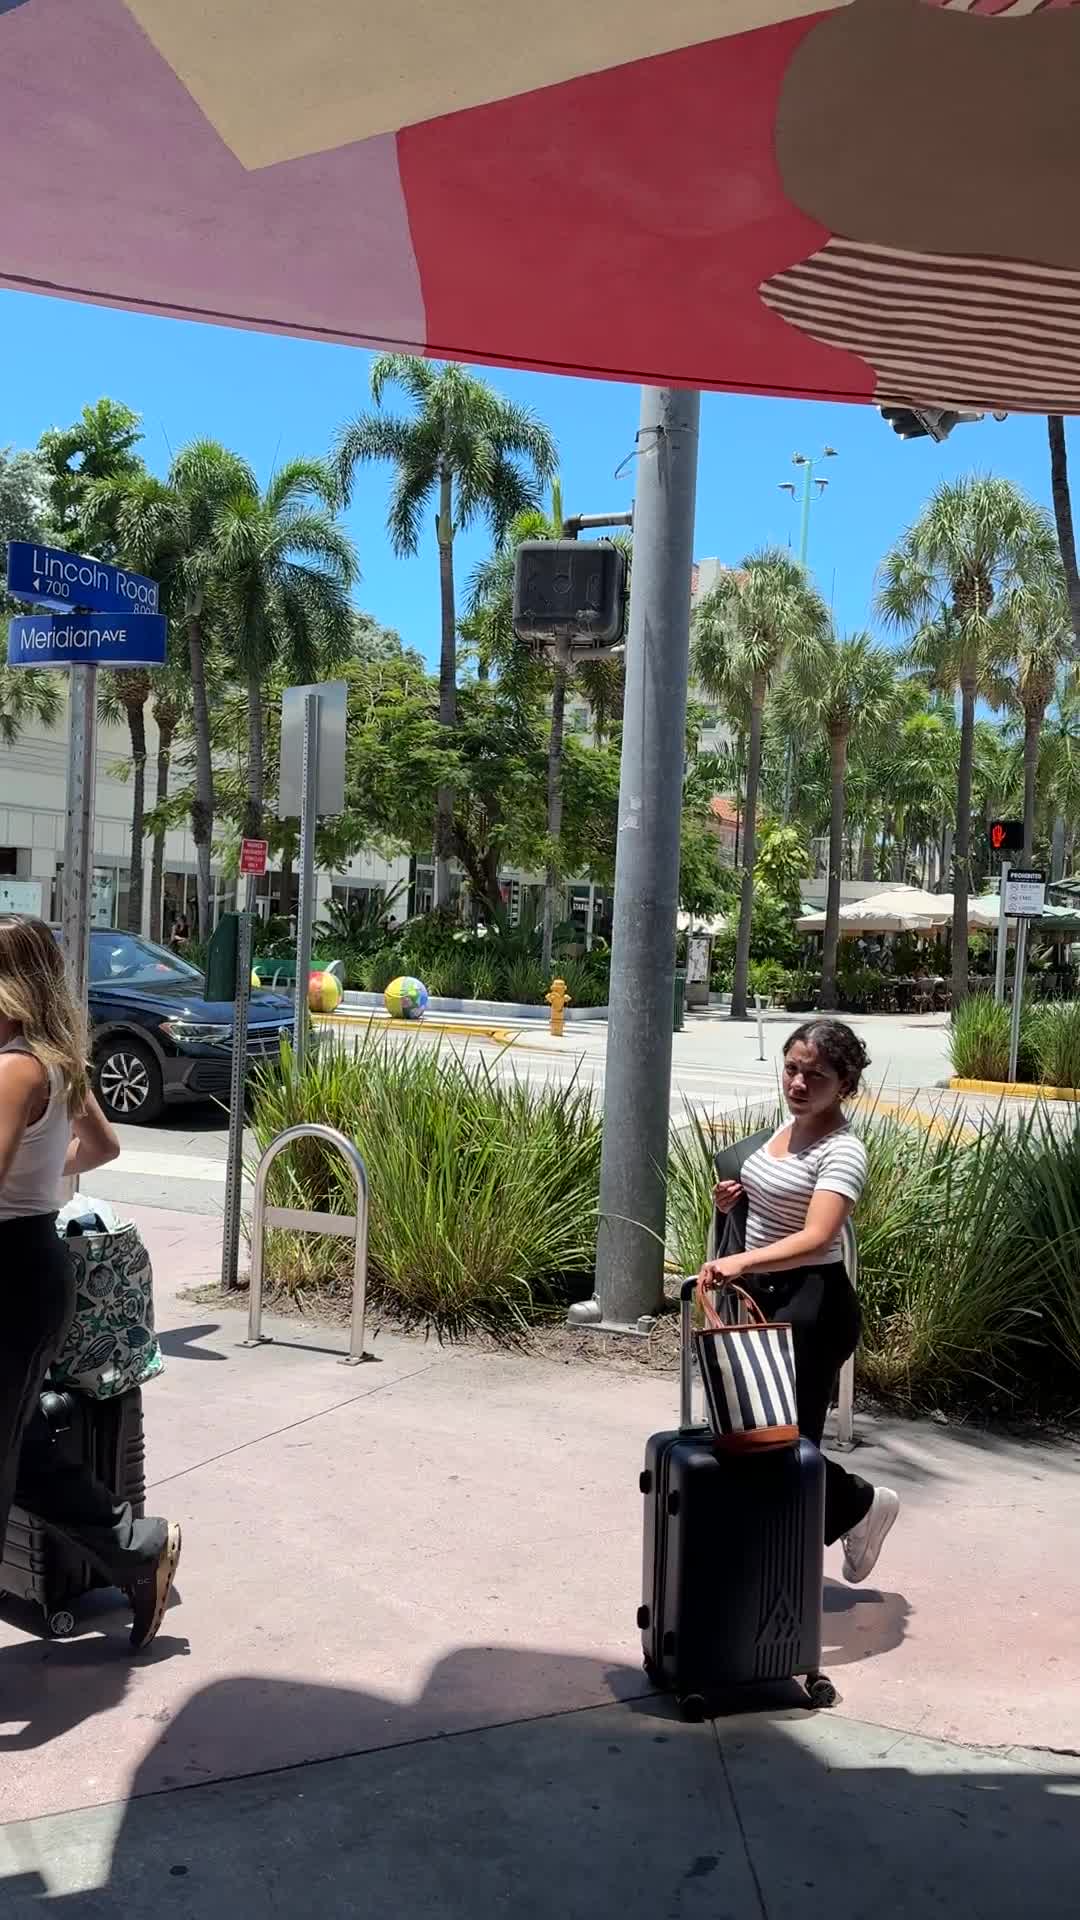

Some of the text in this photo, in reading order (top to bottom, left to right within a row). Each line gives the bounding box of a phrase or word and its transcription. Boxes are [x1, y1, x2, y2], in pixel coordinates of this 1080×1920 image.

[33, 550, 157, 607] Lincoln Road
[46, 580, 70, 598] 700
[20, 626, 127, 650] Meridian AVE
